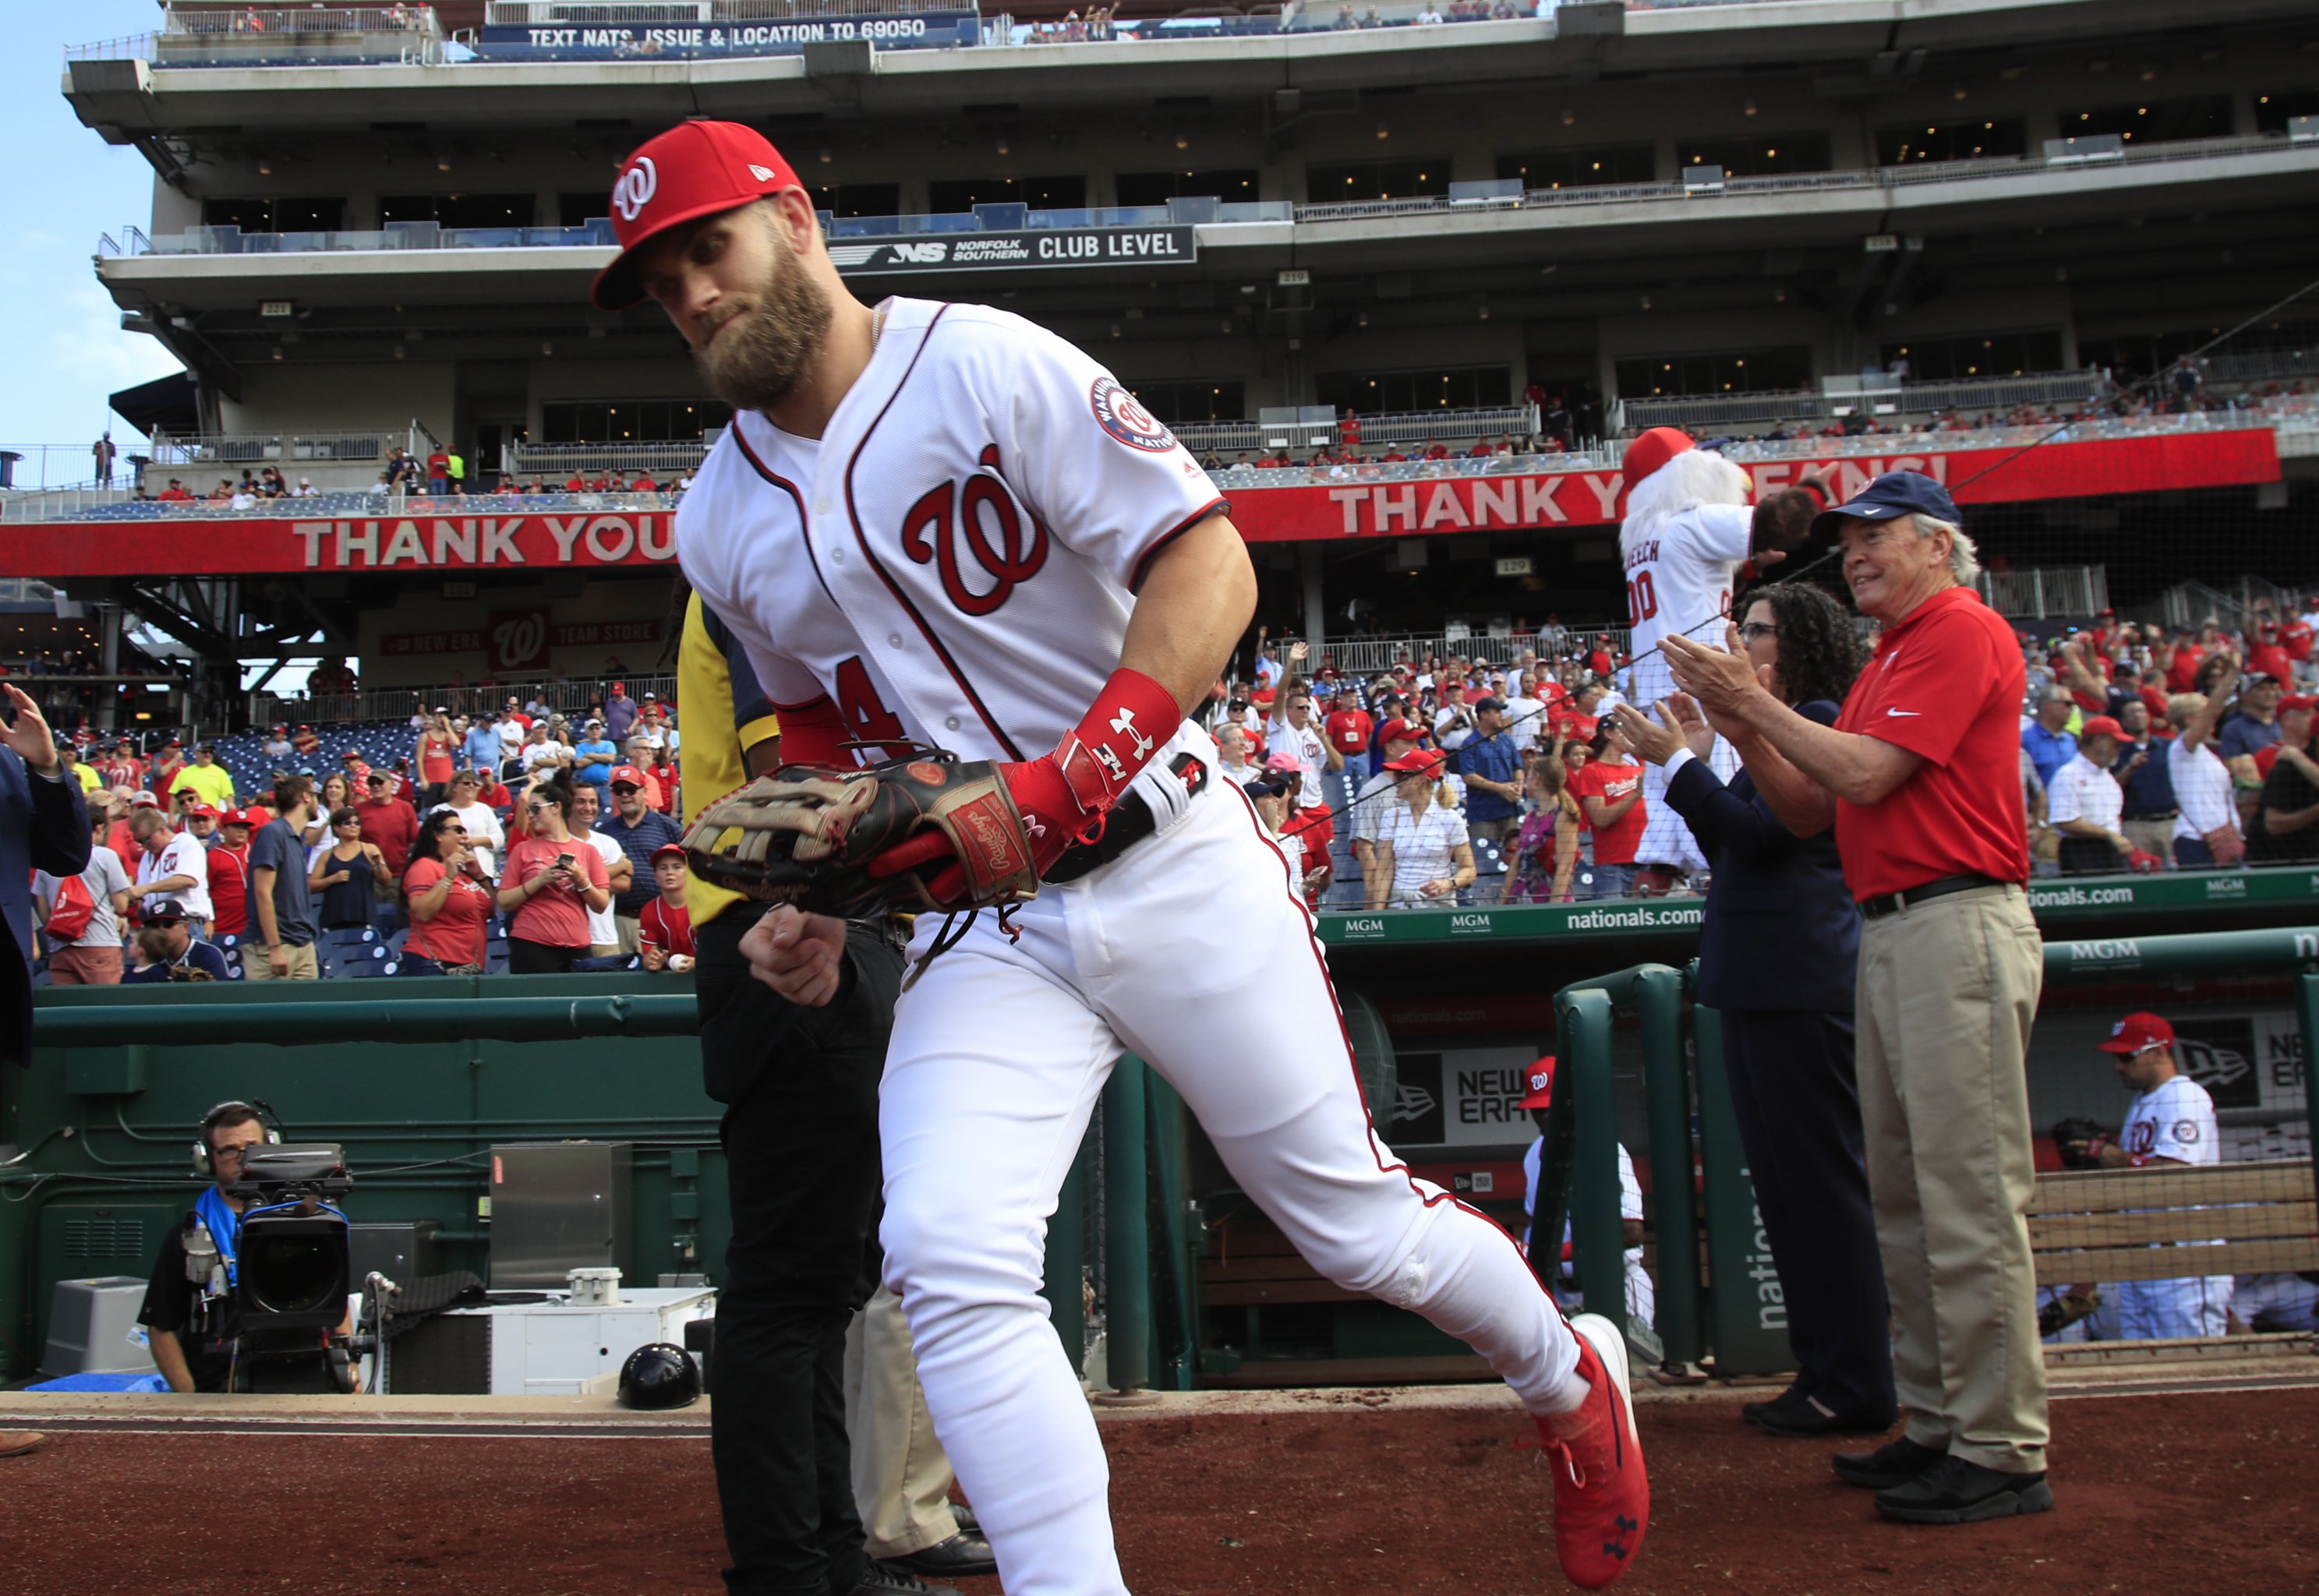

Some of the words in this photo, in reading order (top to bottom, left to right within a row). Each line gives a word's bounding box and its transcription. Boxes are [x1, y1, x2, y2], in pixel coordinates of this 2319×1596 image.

[528, 29, 578, 48] TEXT
[582, 29, 632, 48] NATS
[645, 29, 703, 47] ISSUE
[709, 29, 725, 47] &
[734, 24, 824, 46] LOCATION
[830, 23, 855, 40] TO
[861, 19, 925, 38] 69050
[952, 249, 1030, 262] SOUTHERN
[955, 239, 1022, 252] NORFOLK
[1038, 236, 1100, 259] CLUB
[1108, 233, 1179, 256] LEVEL
[1285, 273, 1304, 282] 219
[267, 304, 285, 313] 221
[1328, 475, 1568, 533] THANK
[292, 517, 525, 567] THANK
[543, 514, 678, 562] YOU
[1504, 560, 1525, 572] 129
[413, 634, 447, 652] NEW
[451, 633, 480, 651] ERA
[559, 626, 599, 644] TEAM
[603, 623, 651, 642] STORE
[1092, 742, 1127, 782] 34
[967, 810, 1011, 870] Rawlings
[2206, 878, 2246, 892] MGM
[1345, 920, 1384, 932] MGM
[1451, 914, 1490, 927] MGM
[1567, 907, 1702, 930] nationals.com
[2070, 940, 2141, 960] MGM
[1458, 1069, 1525, 1097] NEW
